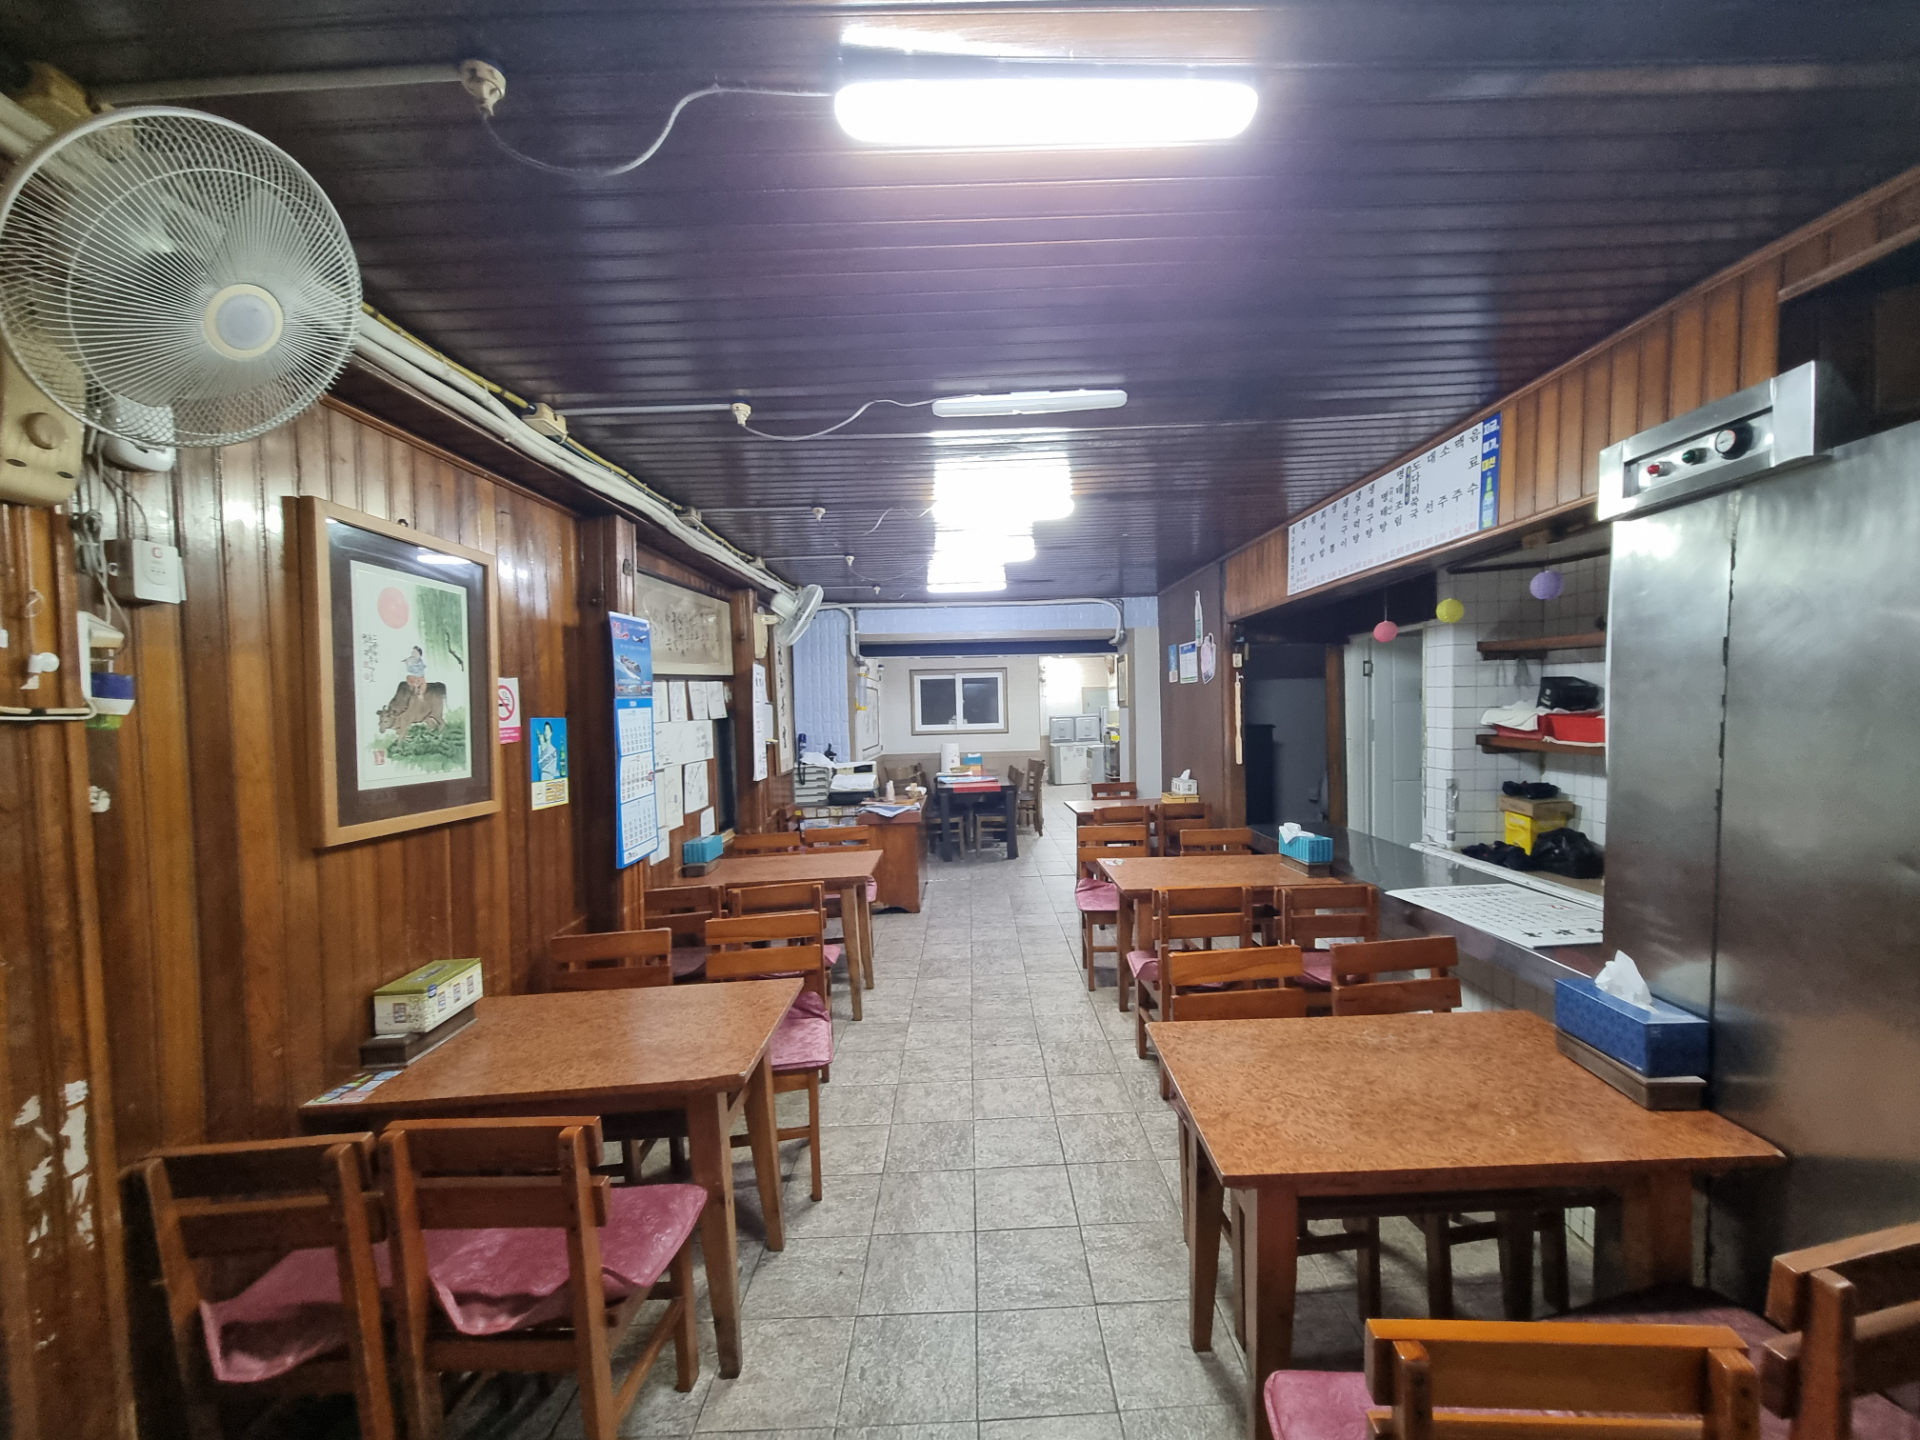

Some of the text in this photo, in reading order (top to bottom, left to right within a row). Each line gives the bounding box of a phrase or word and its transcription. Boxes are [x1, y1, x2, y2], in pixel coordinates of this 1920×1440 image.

[1409, 460, 1422, 519] 도다리쑥국
[1424, 450, 1436, 514] 대선
[1437, 445, 1451, 509] 소주
[1451, 435, 1465, 503] 맥주
[1467, 428, 1481, 495] 음료수
